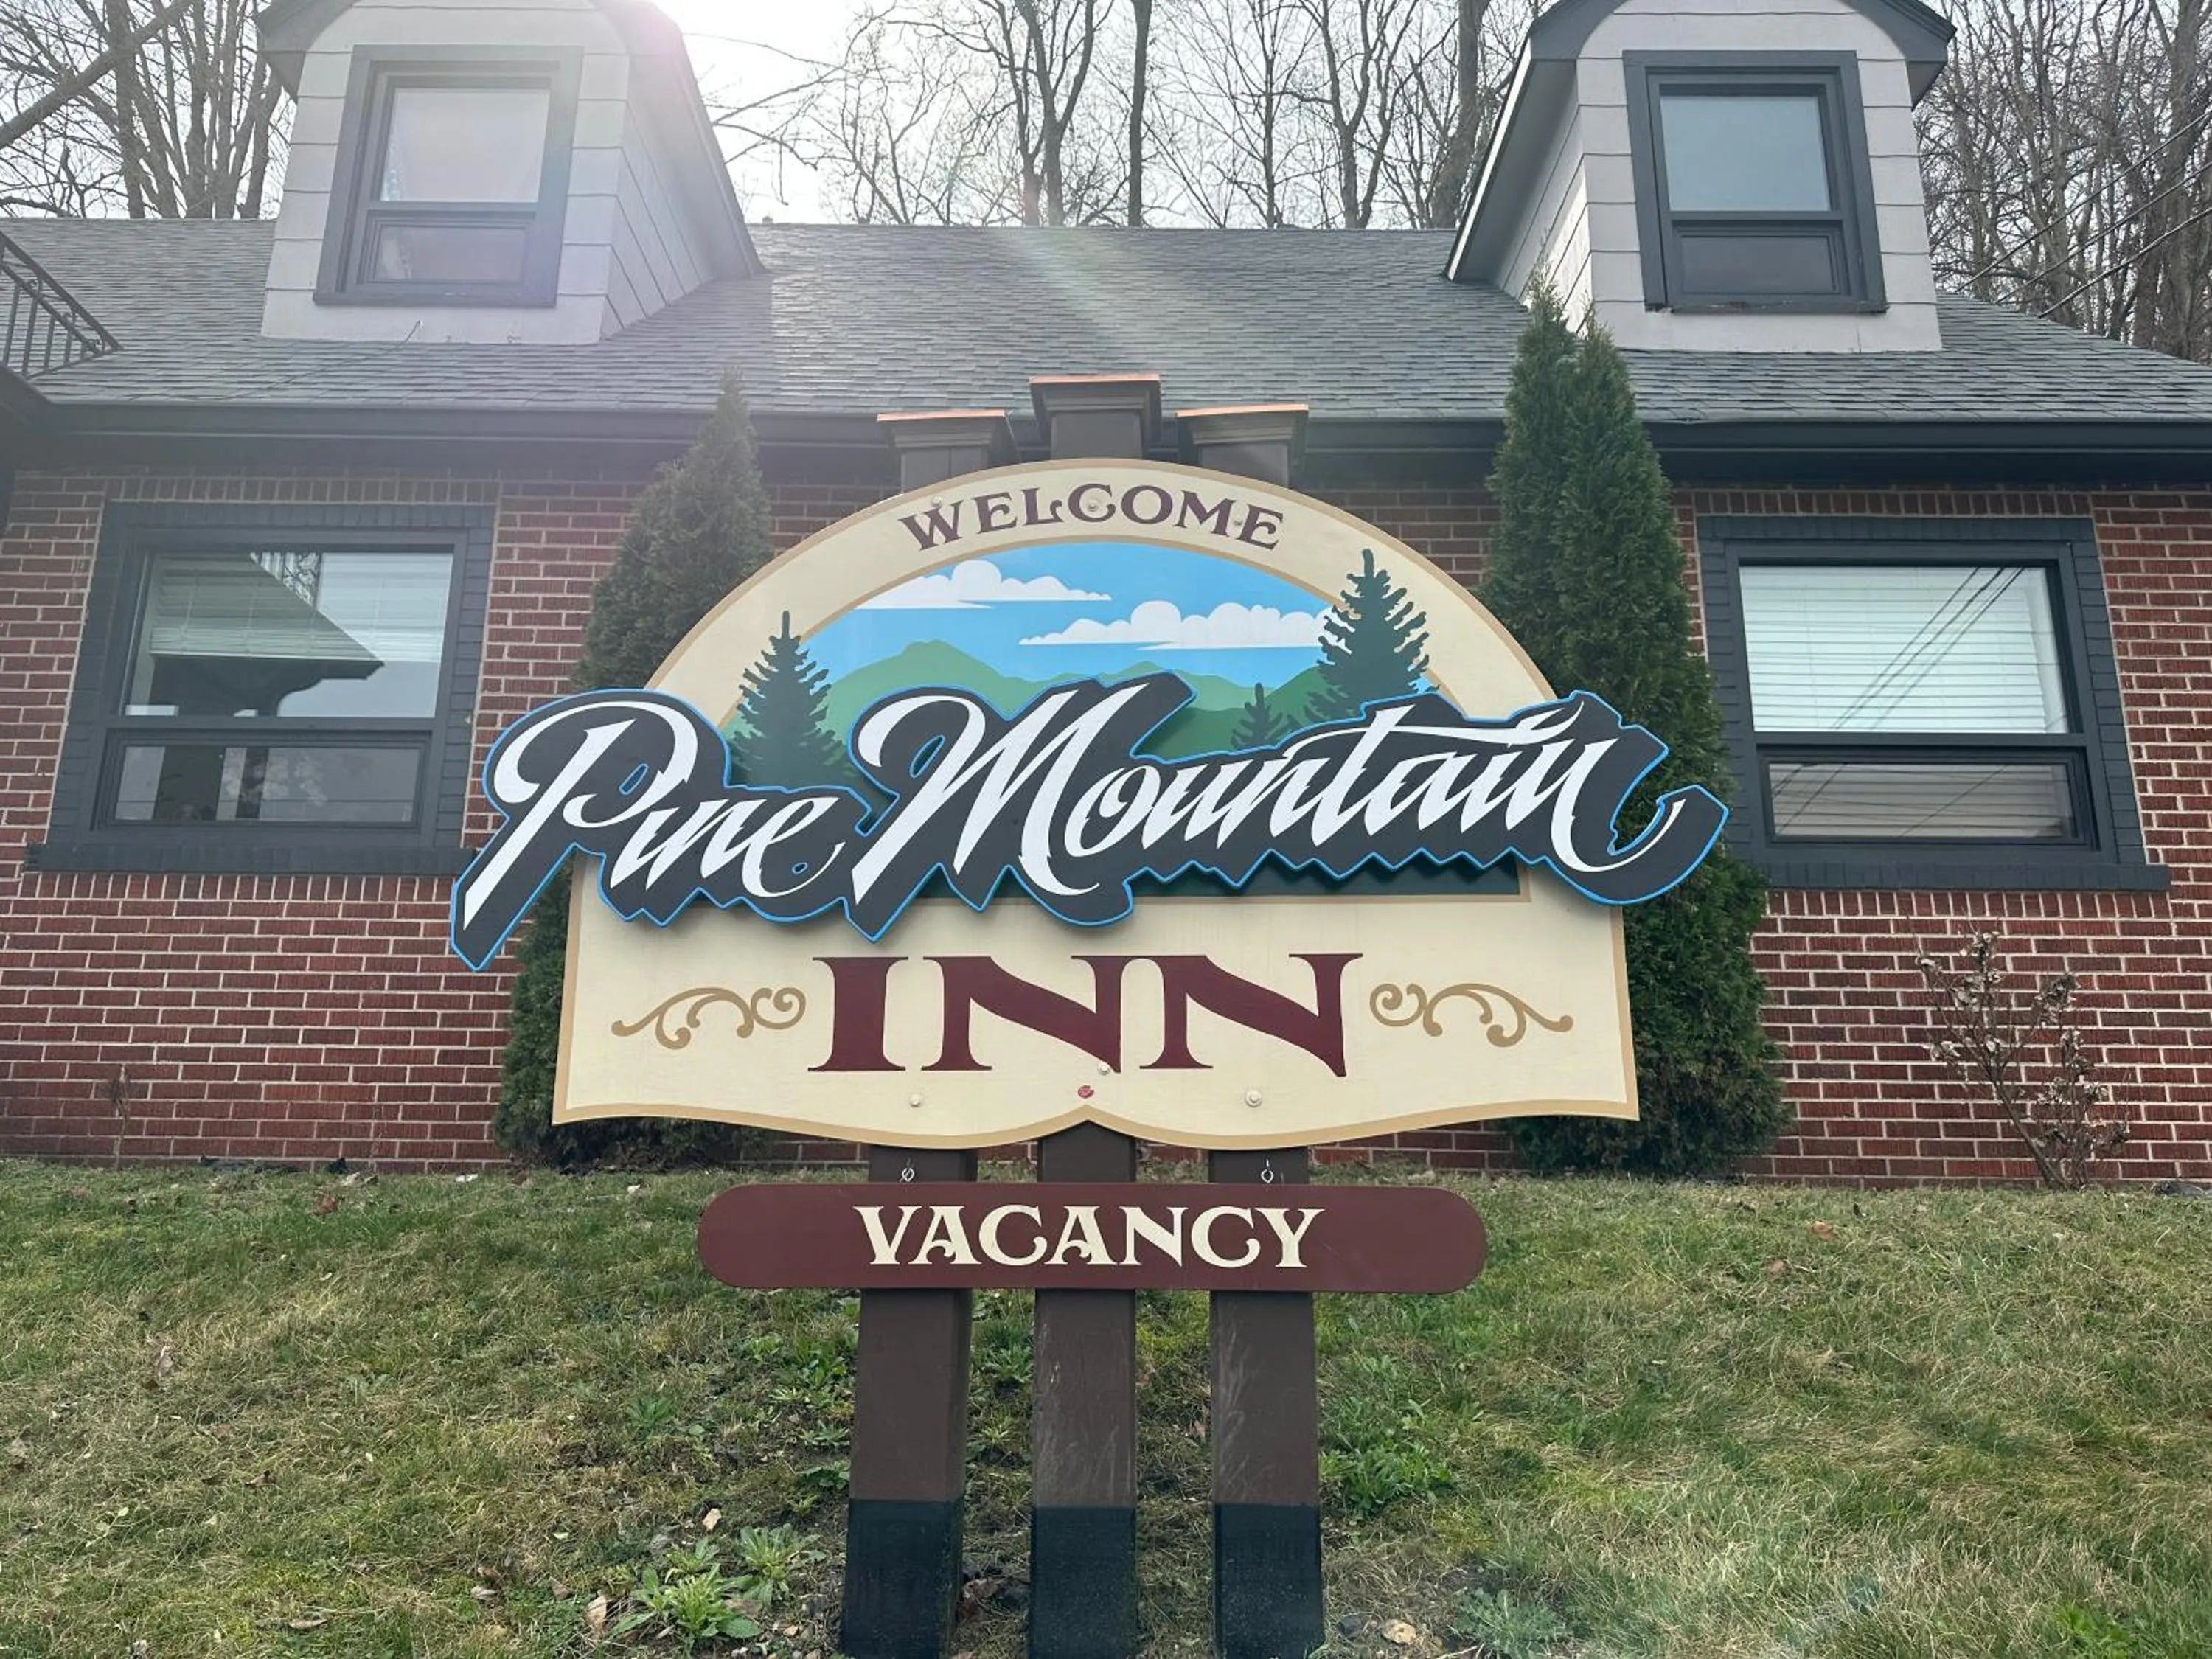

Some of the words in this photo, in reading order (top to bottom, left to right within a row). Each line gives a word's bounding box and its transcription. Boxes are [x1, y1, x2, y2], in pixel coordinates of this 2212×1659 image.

[899, 484, 1284, 551] WELCOME
[464, 701, 845, 930] Pine
[851, 685, 1686, 904] Mountain
[808, 953, 1363, 1077] INN
[854, 1204, 1324, 1269] VACANCY
